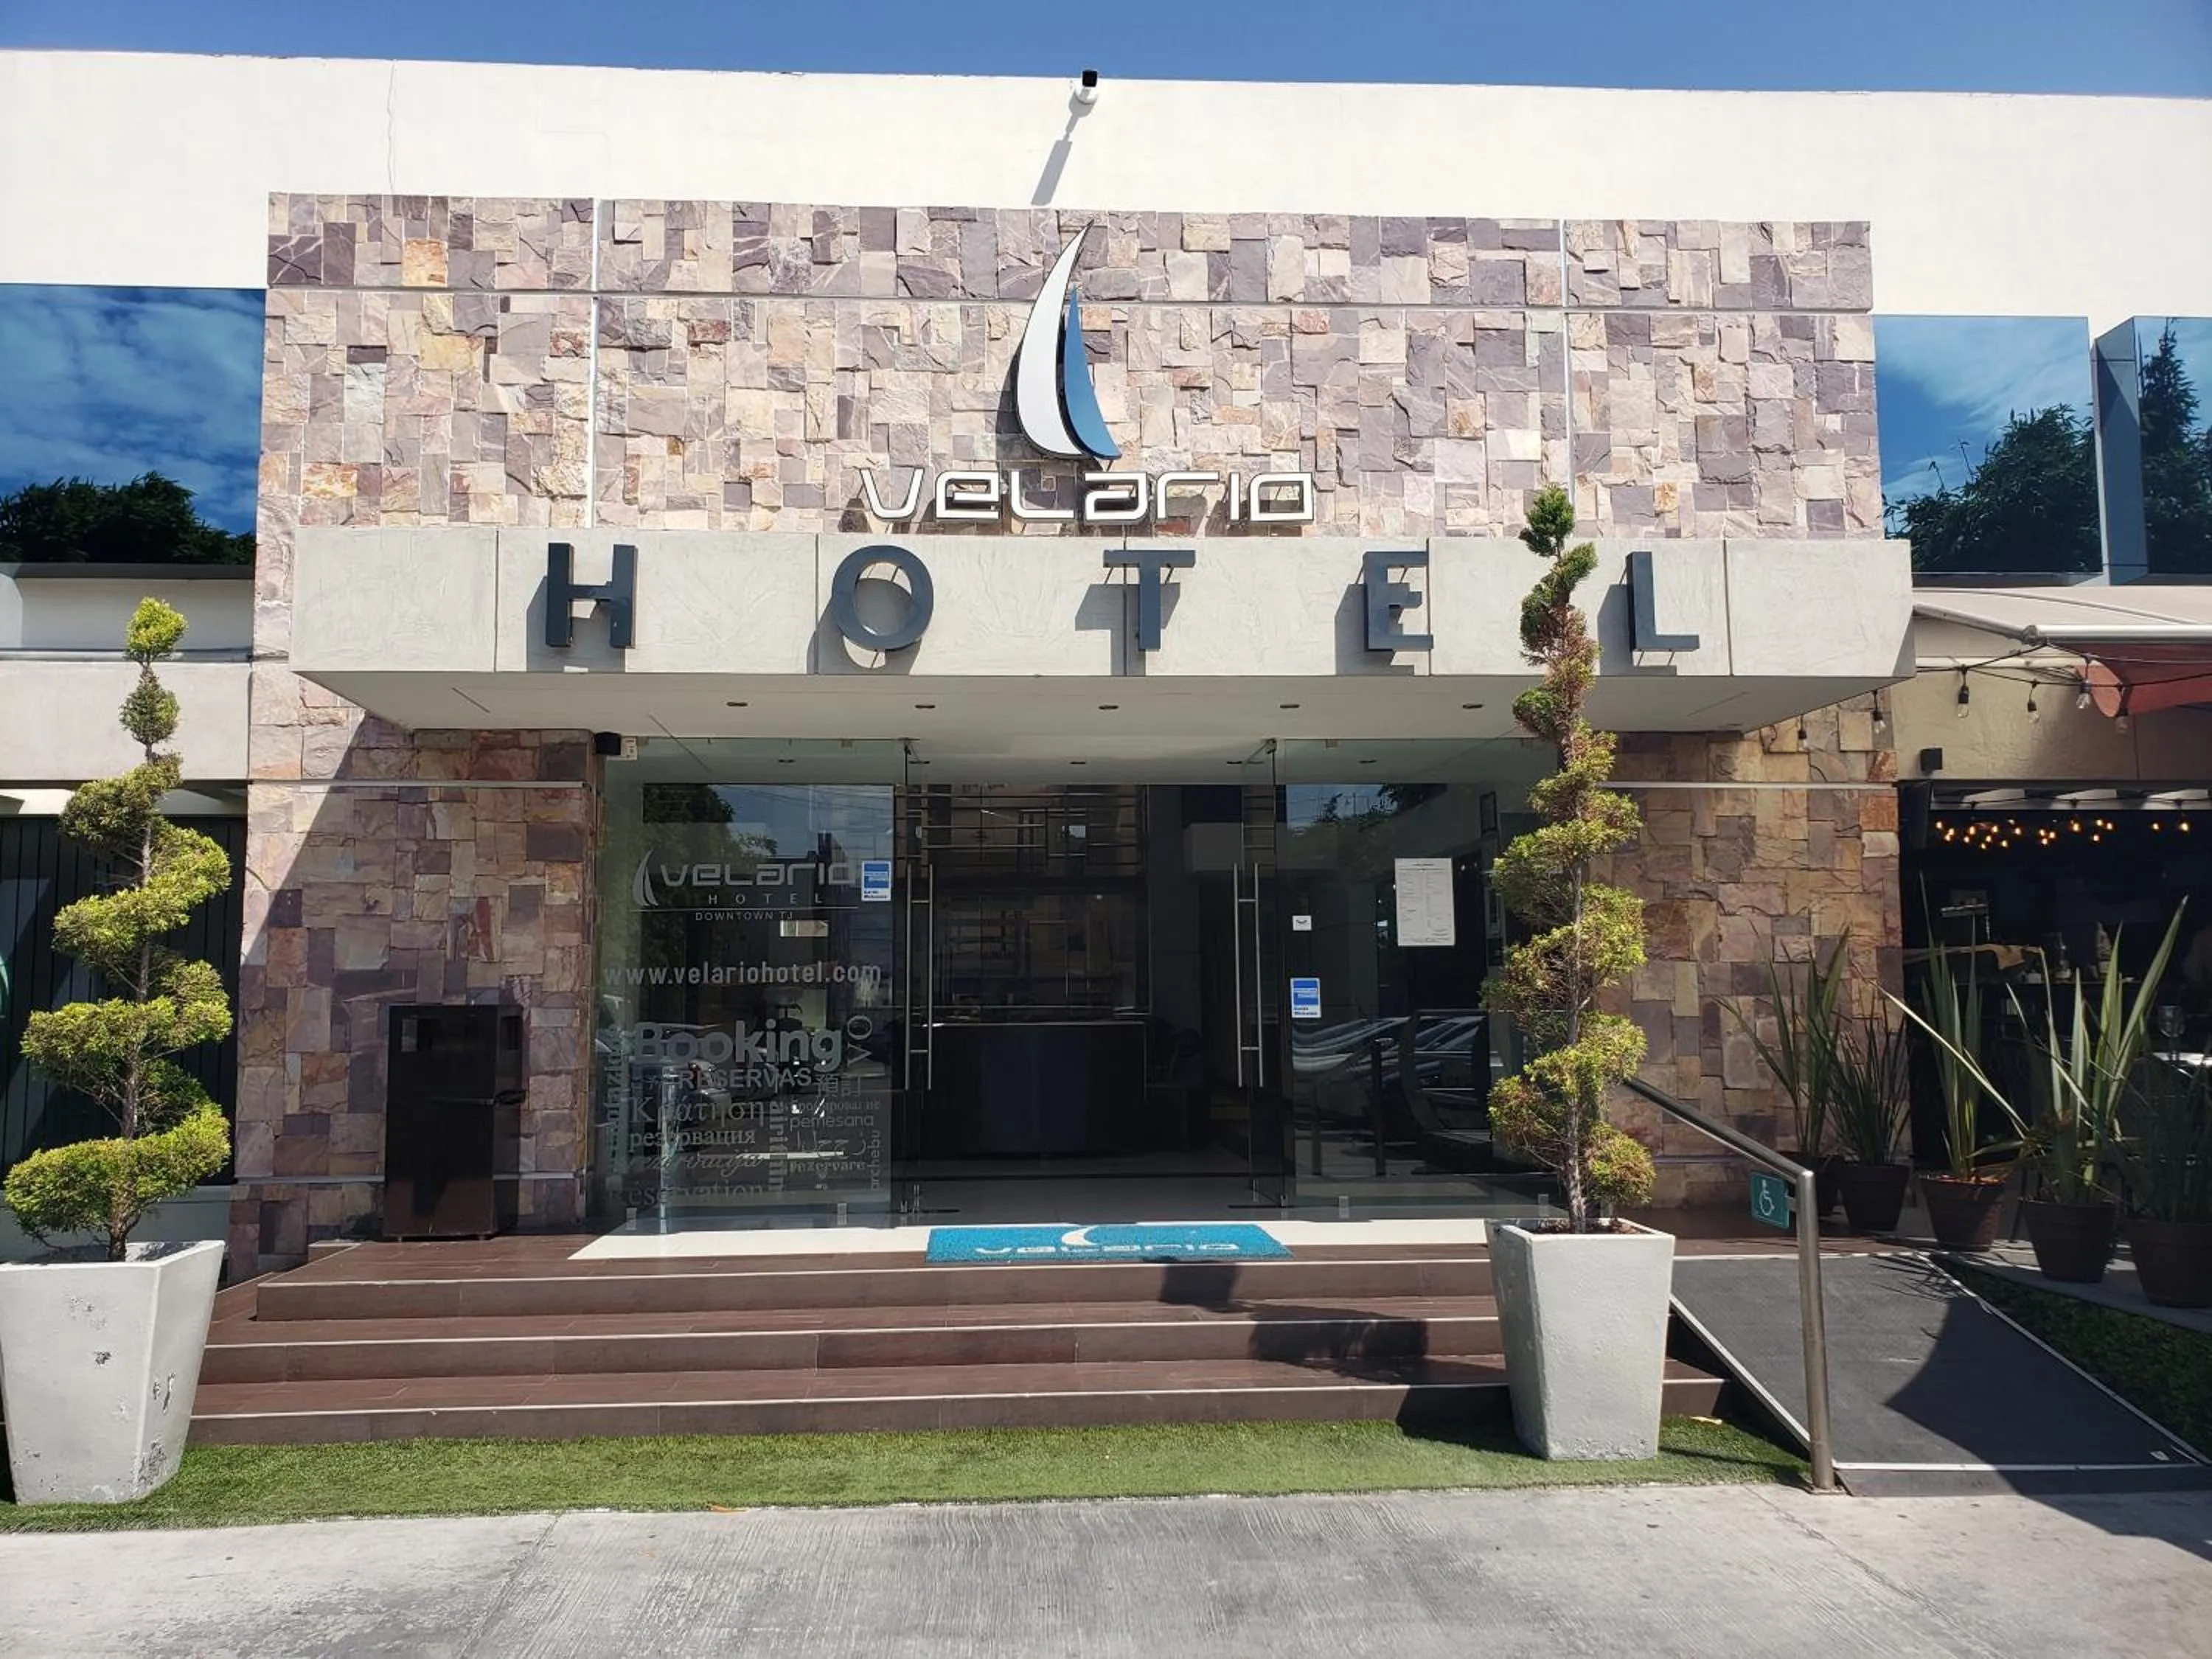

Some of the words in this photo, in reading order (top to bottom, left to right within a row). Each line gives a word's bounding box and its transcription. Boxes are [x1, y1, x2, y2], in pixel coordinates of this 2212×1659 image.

[545, 542, 1700, 653] HOTEL
[708, 893, 824, 905] HOTEL
[695, 911, 773, 922] DOWNTOWN
[779, 911, 793, 920] TJ
[604, 961, 881, 986] www.velariohotel.com
[634, 1018, 842, 1072] Booking
[678, 1068, 811, 1088] RESERVAS
